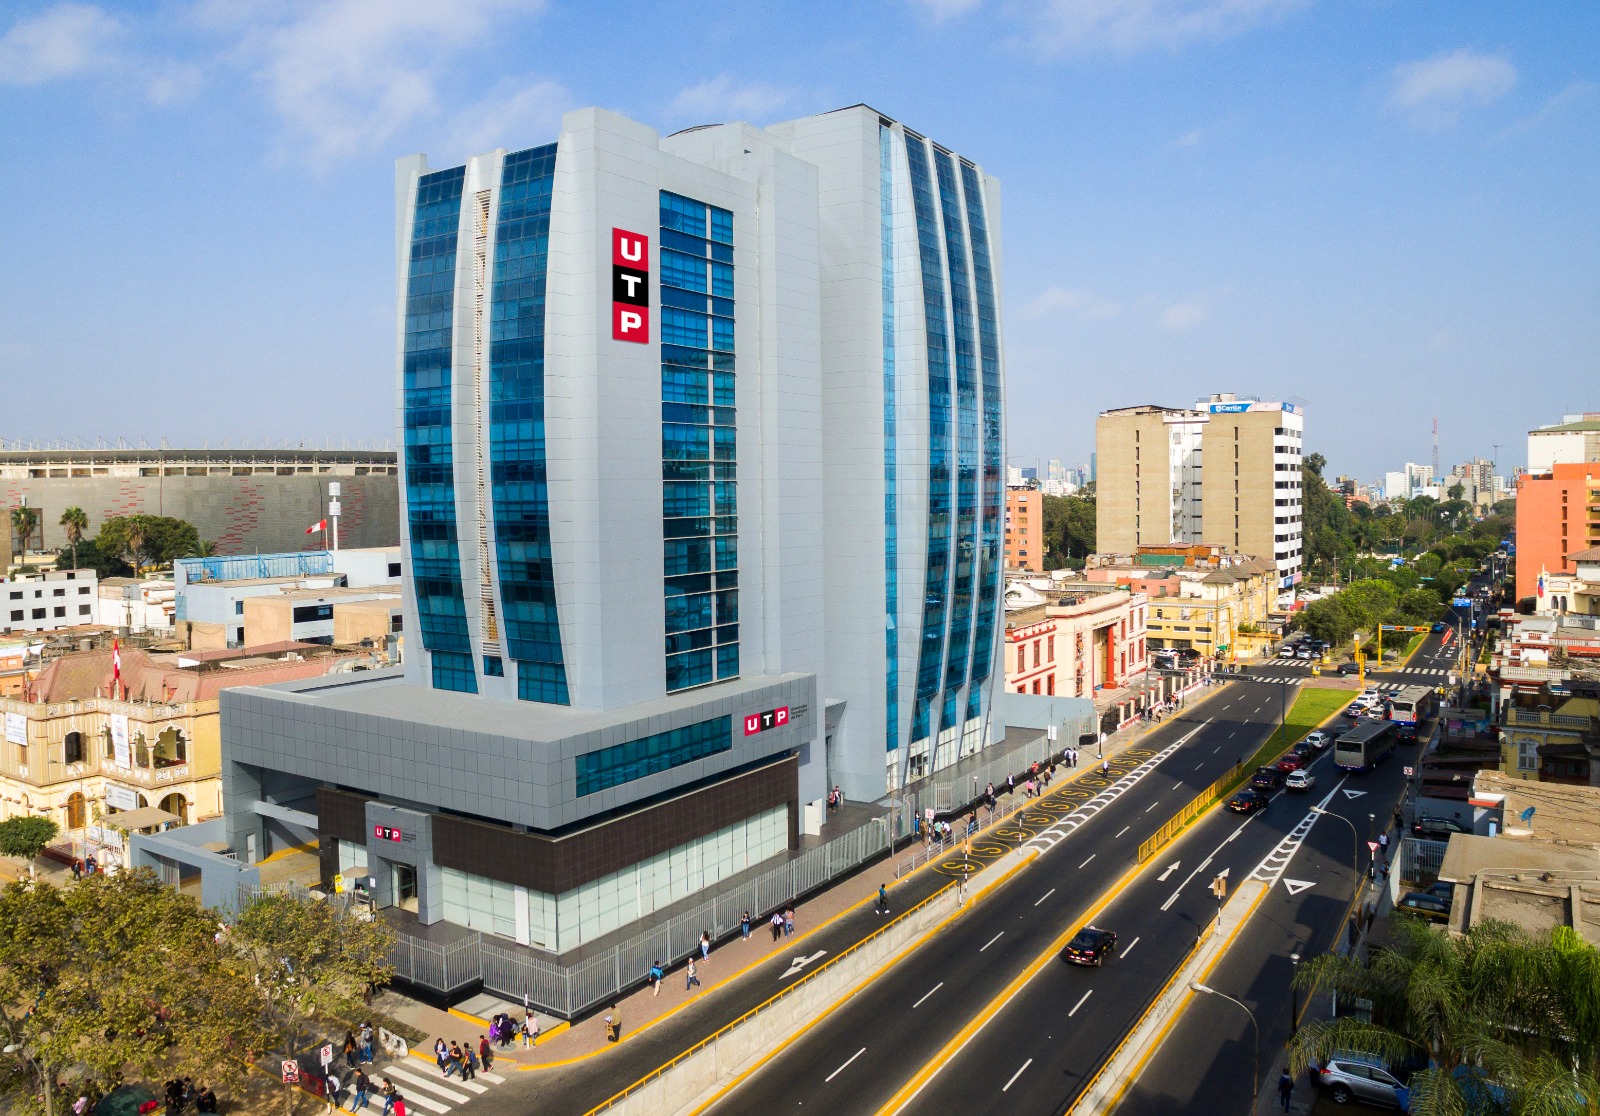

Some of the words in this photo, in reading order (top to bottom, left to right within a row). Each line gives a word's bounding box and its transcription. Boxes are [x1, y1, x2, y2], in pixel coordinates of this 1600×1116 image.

[620, 237, 642, 333] UTP
[747, 710, 786, 731] UTP
[376, 827, 400, 839] UTP
